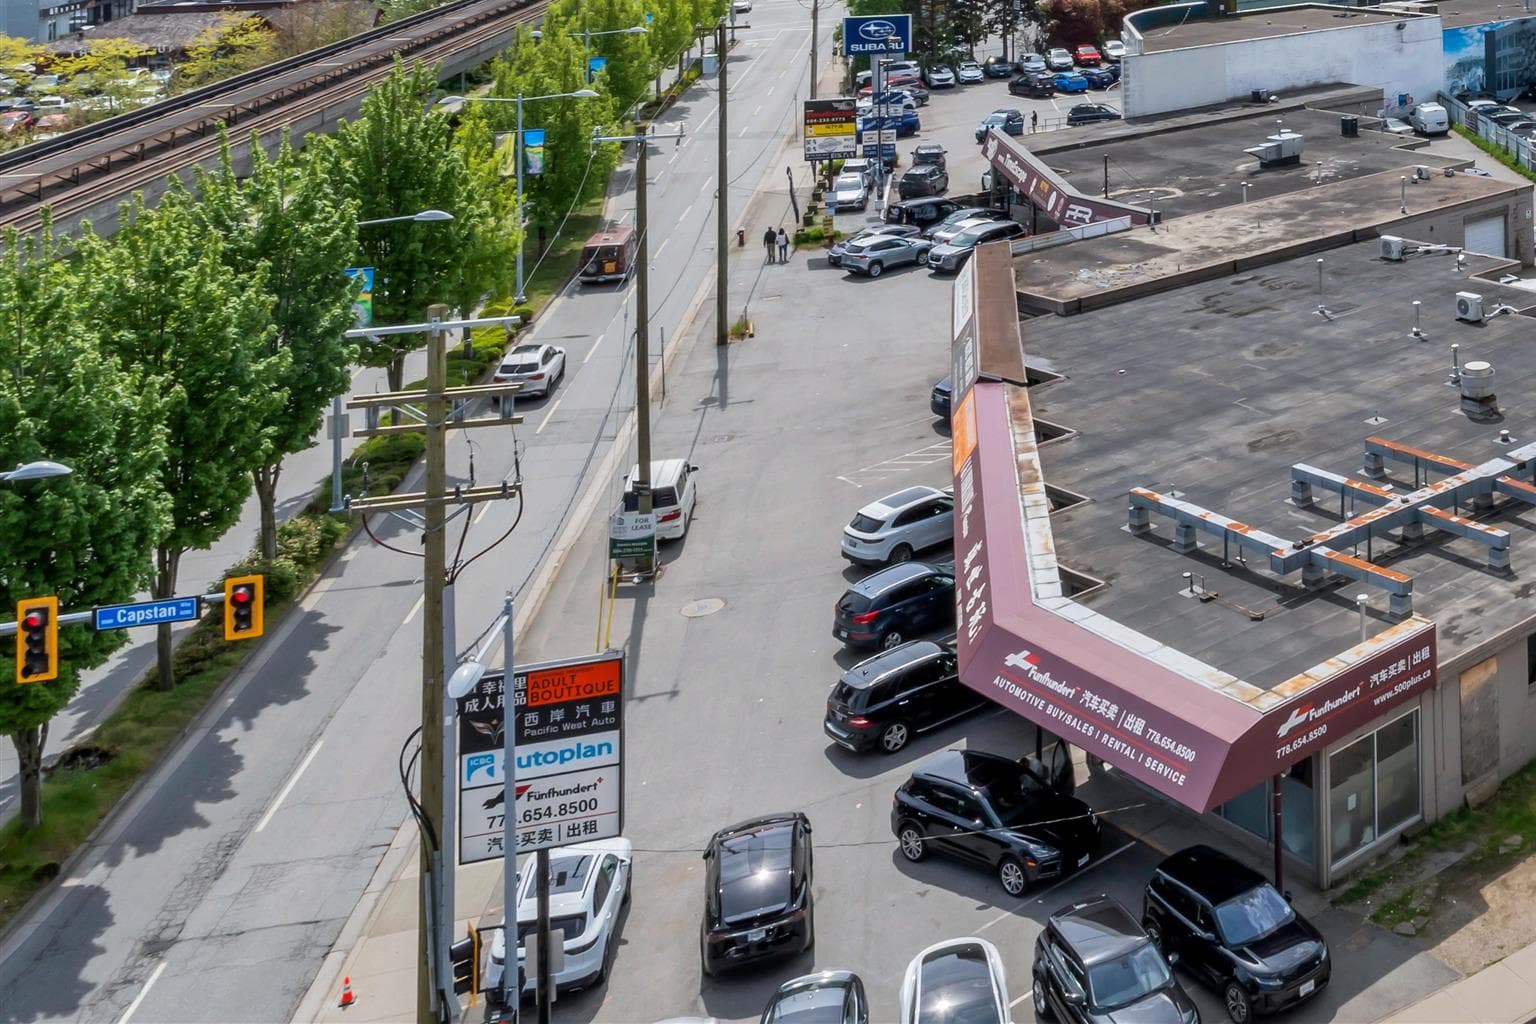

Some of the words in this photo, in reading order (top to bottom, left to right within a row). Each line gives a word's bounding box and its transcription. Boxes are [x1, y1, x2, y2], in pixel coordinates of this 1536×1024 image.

[850, 42, 905, 52] SUBARU
[116, 606, 177, 624] Capstan
[530, 675, 578, 692] ADULT
[530, 680, 615, 703] BOUTIQUE
[1373, 668, 1432, 706] www.500plus.ca
[524, 725, 559, 737] Pacific
[562, 721, 587, 732] West
[591, 716, 616, 727] Auto
[993, 675, 1046, 710] AUTOMOTIVE
[1046, 704, 1094, 737] BUY/SALES
[1101, 734, 1136, 760] RENTAL
[1144, 757, 1186, 786] SERVICE
[1079, 689, 1120, 721] 汽车买卖
[1123, 714, 1147, 736] 出租
[1147, 727, 1196, 762] 778.654.8500
[502, 742, 613, 771] utoplan
[1276, 724, 1328, 760] 778.654.8500
[469, 755, 494, 767] ICBC
[487, 798, 598, 829] 77.654.8500
[487, 828, 553, 852] 汽买卖
[566, 819, 599, 838] 出租
